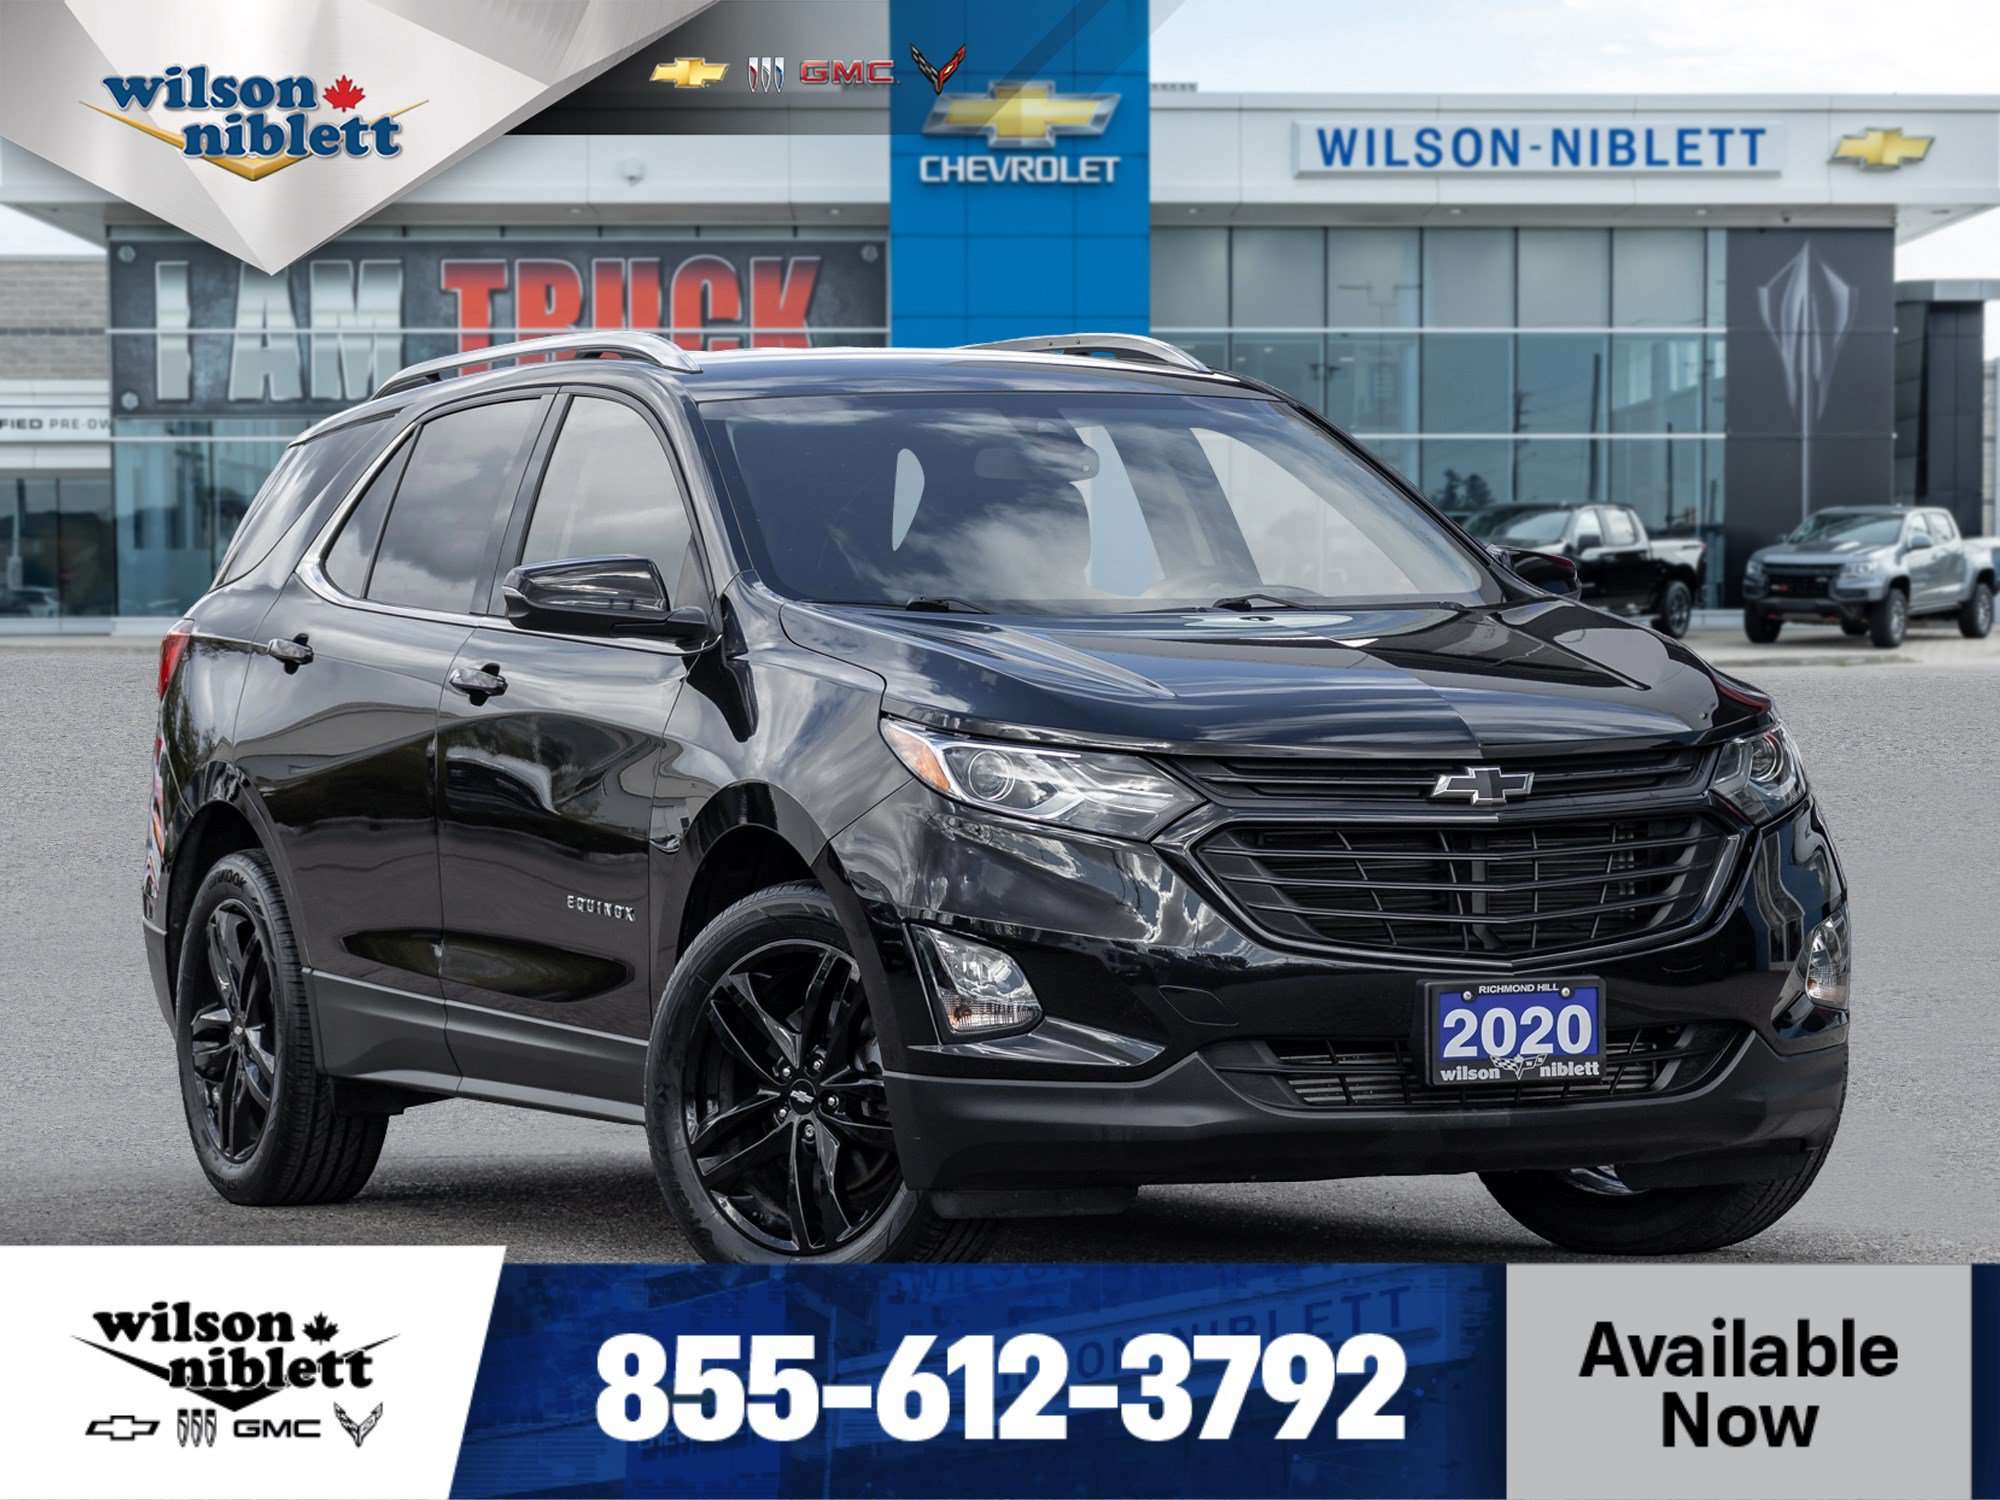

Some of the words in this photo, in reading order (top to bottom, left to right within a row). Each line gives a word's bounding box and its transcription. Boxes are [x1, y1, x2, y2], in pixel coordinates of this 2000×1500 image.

[1316, 127, 1766, 169] WILSON-NIBLETT
[918, 155, 1120, 184] CHEVROLET
[228, 260, 404, 400] AM
[566, 894, 636, 922] EQUINOX
[1478, 983, 1535, 995] RICHMOND
[1537, 983, 1560, 992] HILL
[1442, 1004, 1593, 1059] 2020
[1440, 1062, 1501, 1082] wilson
[1539, 1060, 1600, 1078] niblett
